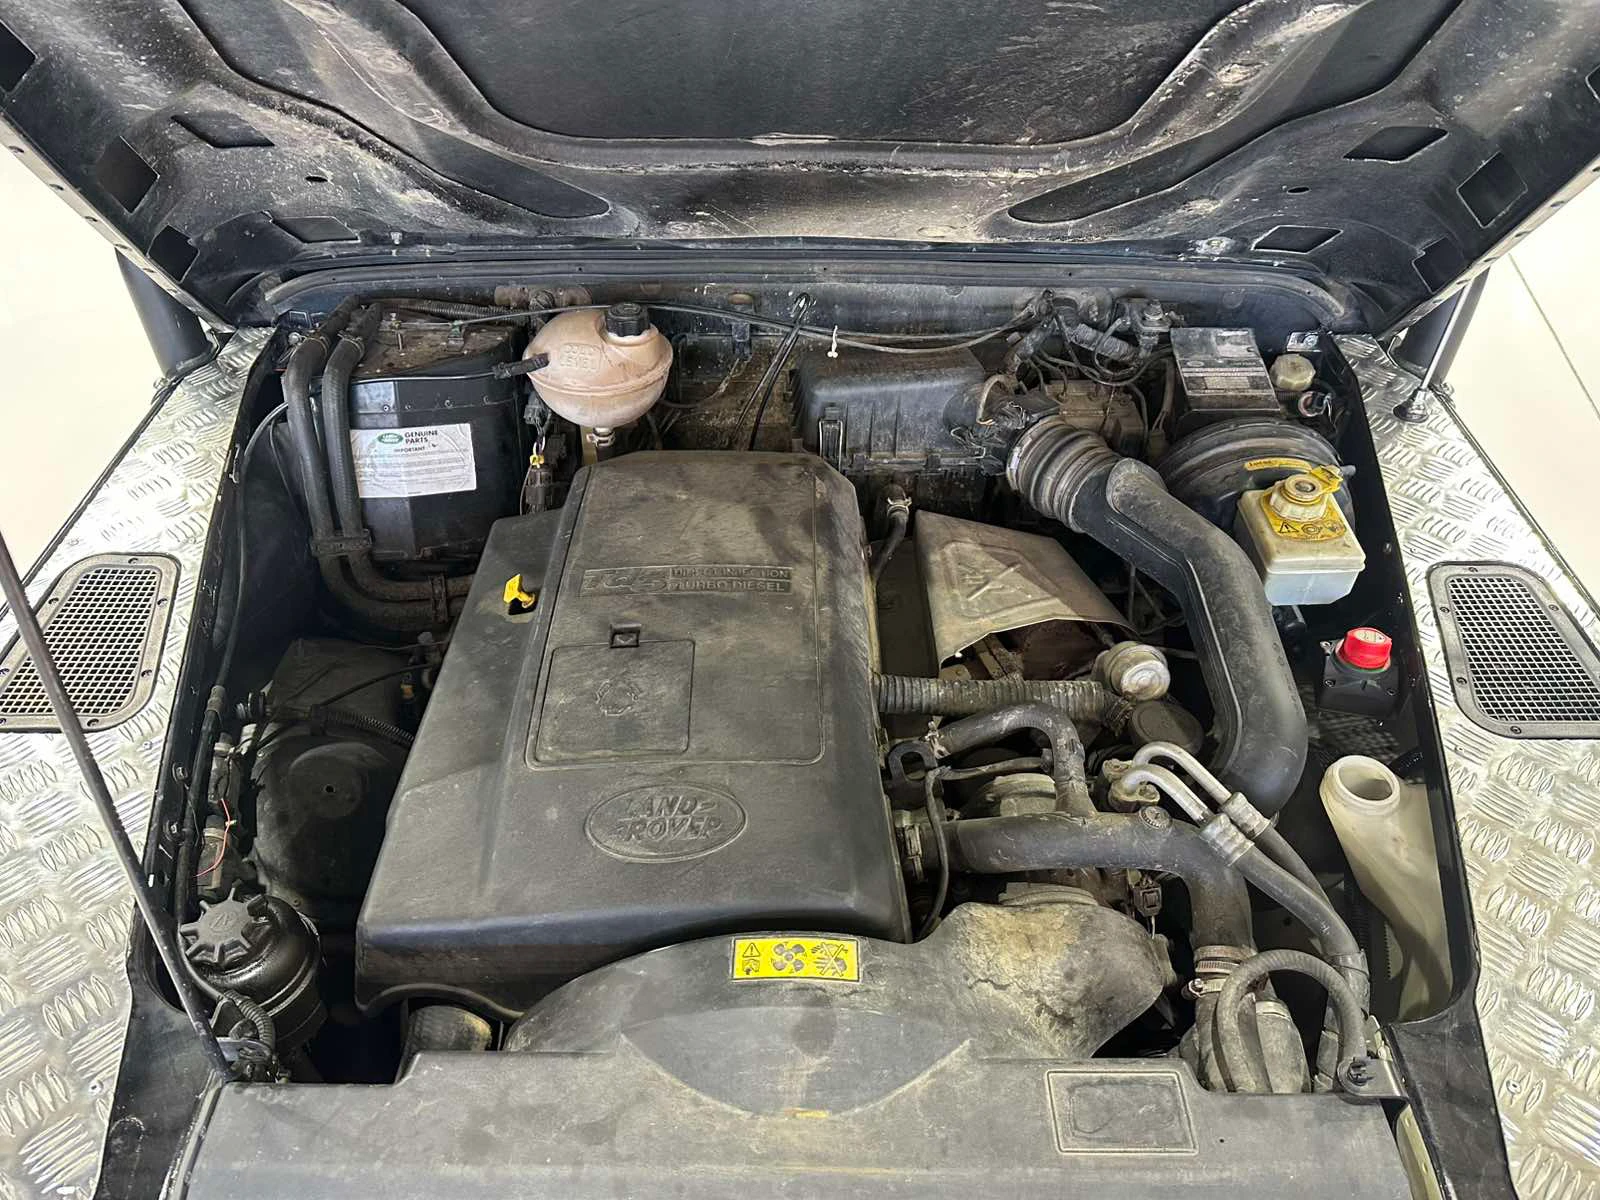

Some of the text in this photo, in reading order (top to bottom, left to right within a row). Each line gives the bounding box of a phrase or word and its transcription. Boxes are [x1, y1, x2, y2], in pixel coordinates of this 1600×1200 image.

[404, 430, 438, 438] GENUINE
[405, 436, 428, 444] PARTS
[732, 580, 785, 592] DIESEL
[622, 815, 722, 841] ROVER
